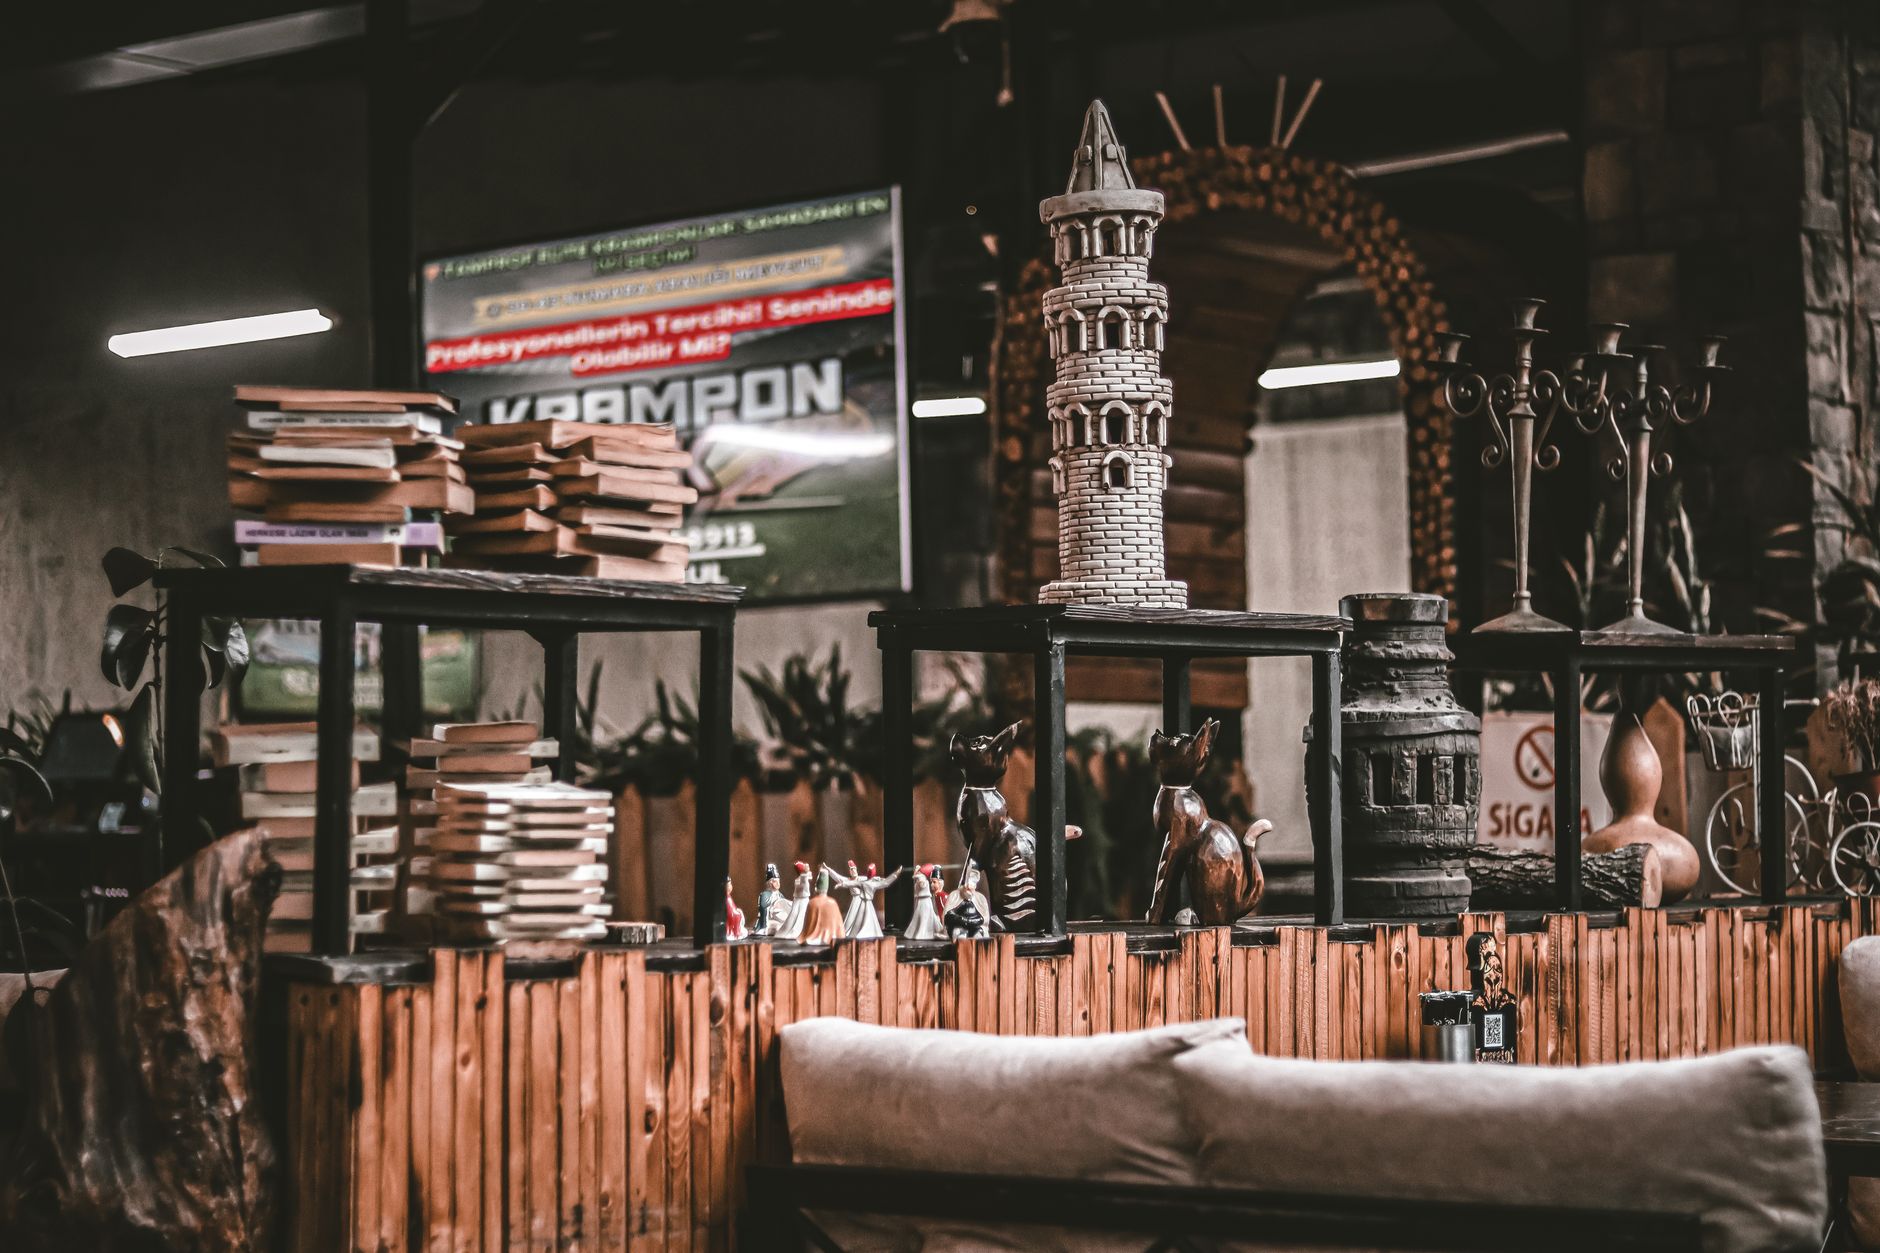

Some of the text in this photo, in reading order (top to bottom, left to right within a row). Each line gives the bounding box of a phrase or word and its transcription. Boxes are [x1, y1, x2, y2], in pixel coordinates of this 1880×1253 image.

[427, 319, 649, 367] Profesyonellerin
[768, 285, 893, 320] Seninde
[572, 332, 732, 372] Olabilir Mi?
[488, 359, 843, 430] KRAMPON
